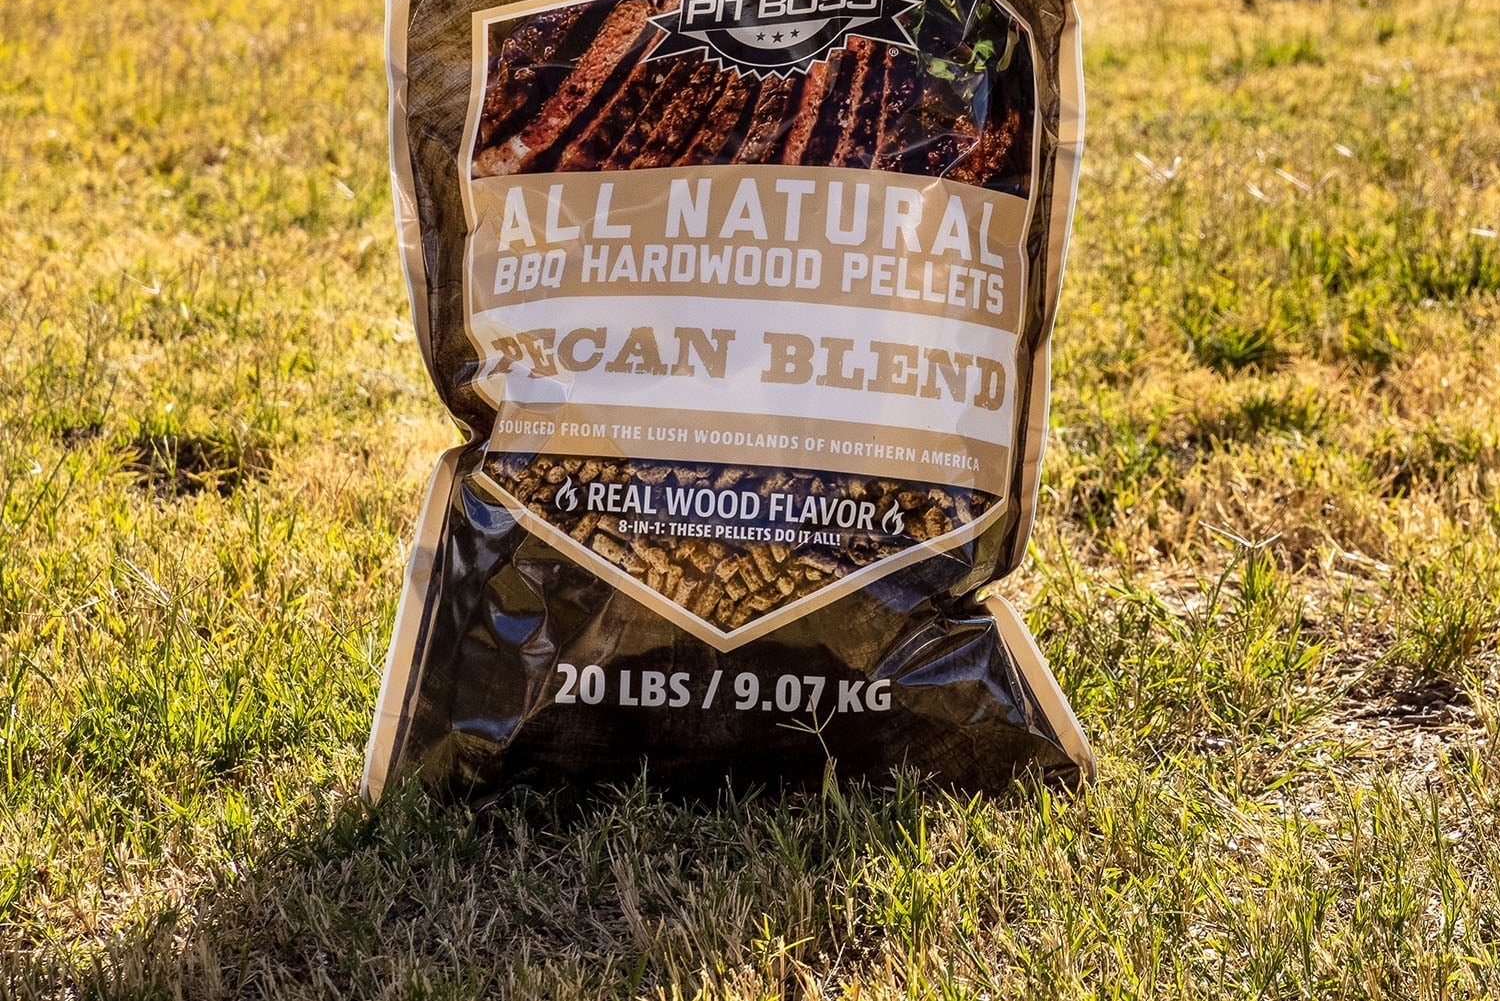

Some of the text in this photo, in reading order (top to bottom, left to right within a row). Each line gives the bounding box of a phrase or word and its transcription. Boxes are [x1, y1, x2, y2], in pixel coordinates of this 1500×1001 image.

[497, 177, 1005, 270] ALL NATURAL
[493, 243, 1005, 315] BBQ HARDWOOD PELLETS
[486, 326, 1007, 412] PECAN BLEND
[498, 419, 981, 473] SOURCED FROM THE LUSH WOODLANDS OF NORTHERN AMERICA
[586, 482, 877, 531] REAL WOOD FLAVOR
[618, 519, 841, 547] 8-IN-1: THESE PELLETS DO IT ALL!
[553, 663, 606, 705] 20
[618, 669, 692, 708] LBS
[733, 672, 827, 713] 9.07
[837, 678, 892, 713] KG
